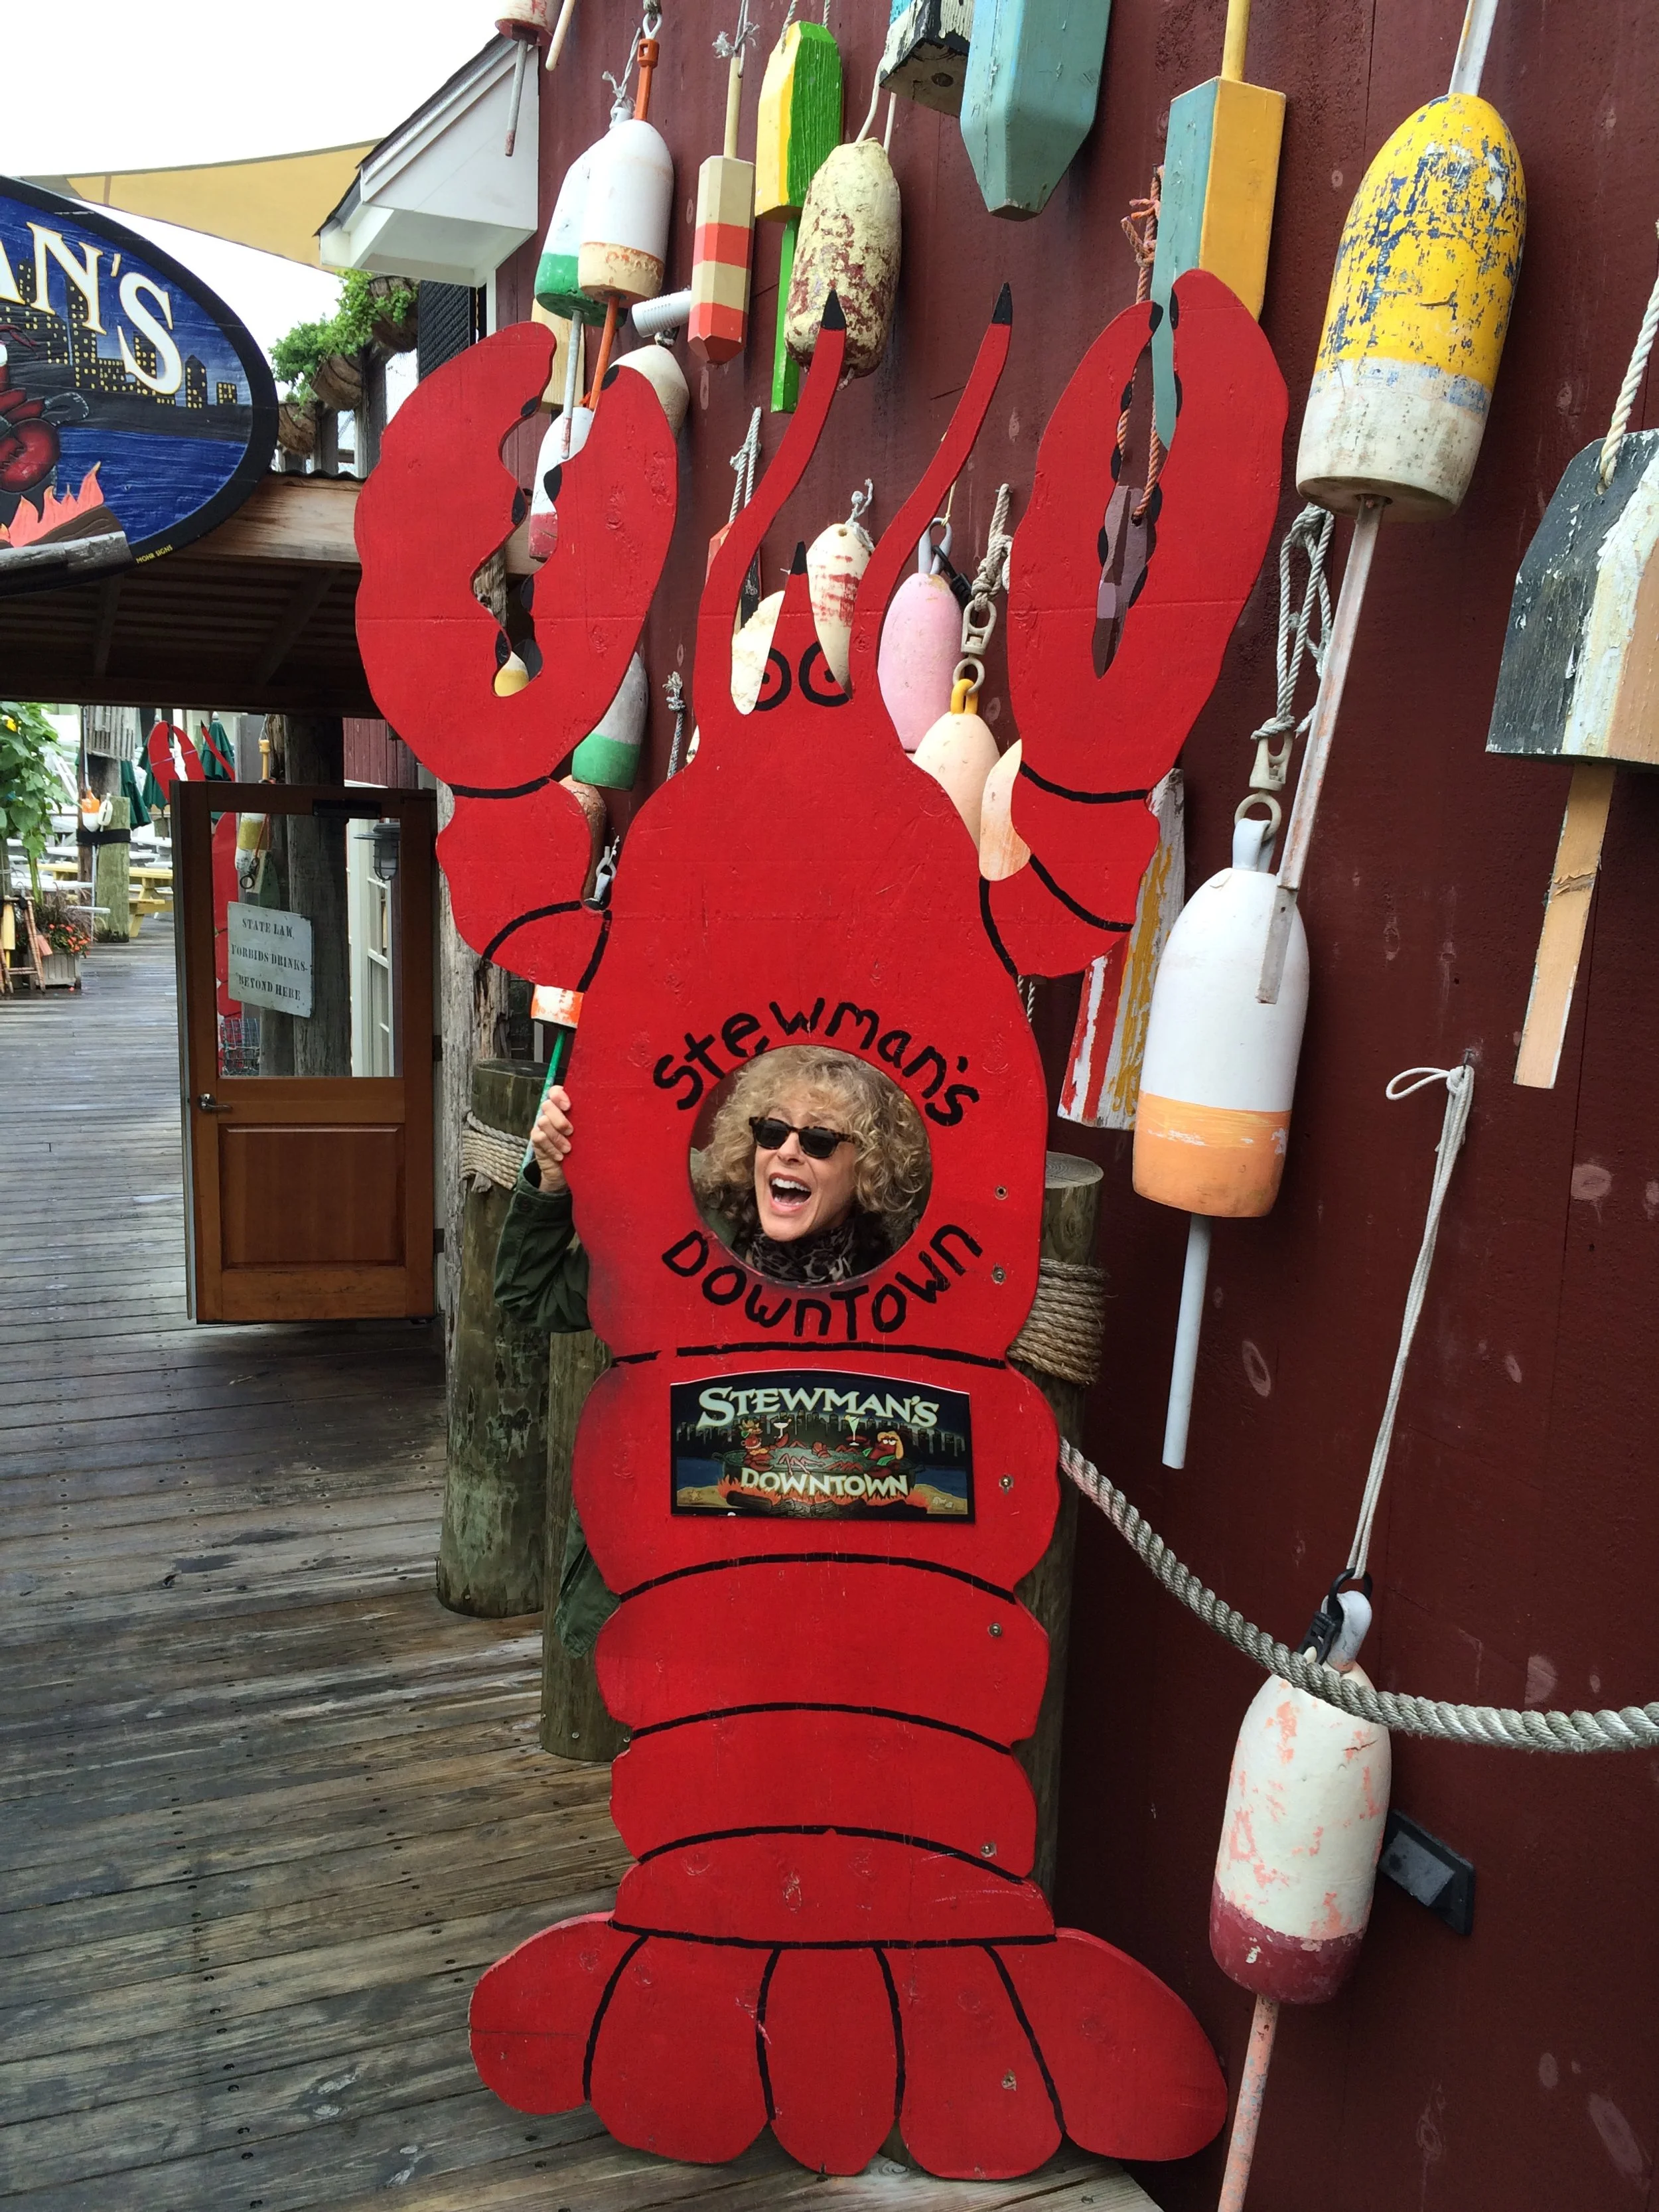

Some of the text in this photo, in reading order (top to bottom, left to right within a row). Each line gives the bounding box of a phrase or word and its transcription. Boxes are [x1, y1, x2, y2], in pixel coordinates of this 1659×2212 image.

[155, 544, 173, 557] SIGNS
[242, 918, 271, 933] STATE
[232, 944, 269, 962] FORBIDS
[238, 974, 301, 1001] BEYOND HERE
[697, 1386, 940, 1429] STEWMAN'S
[740, 1467, 908, 1497] DOWNTOWN
